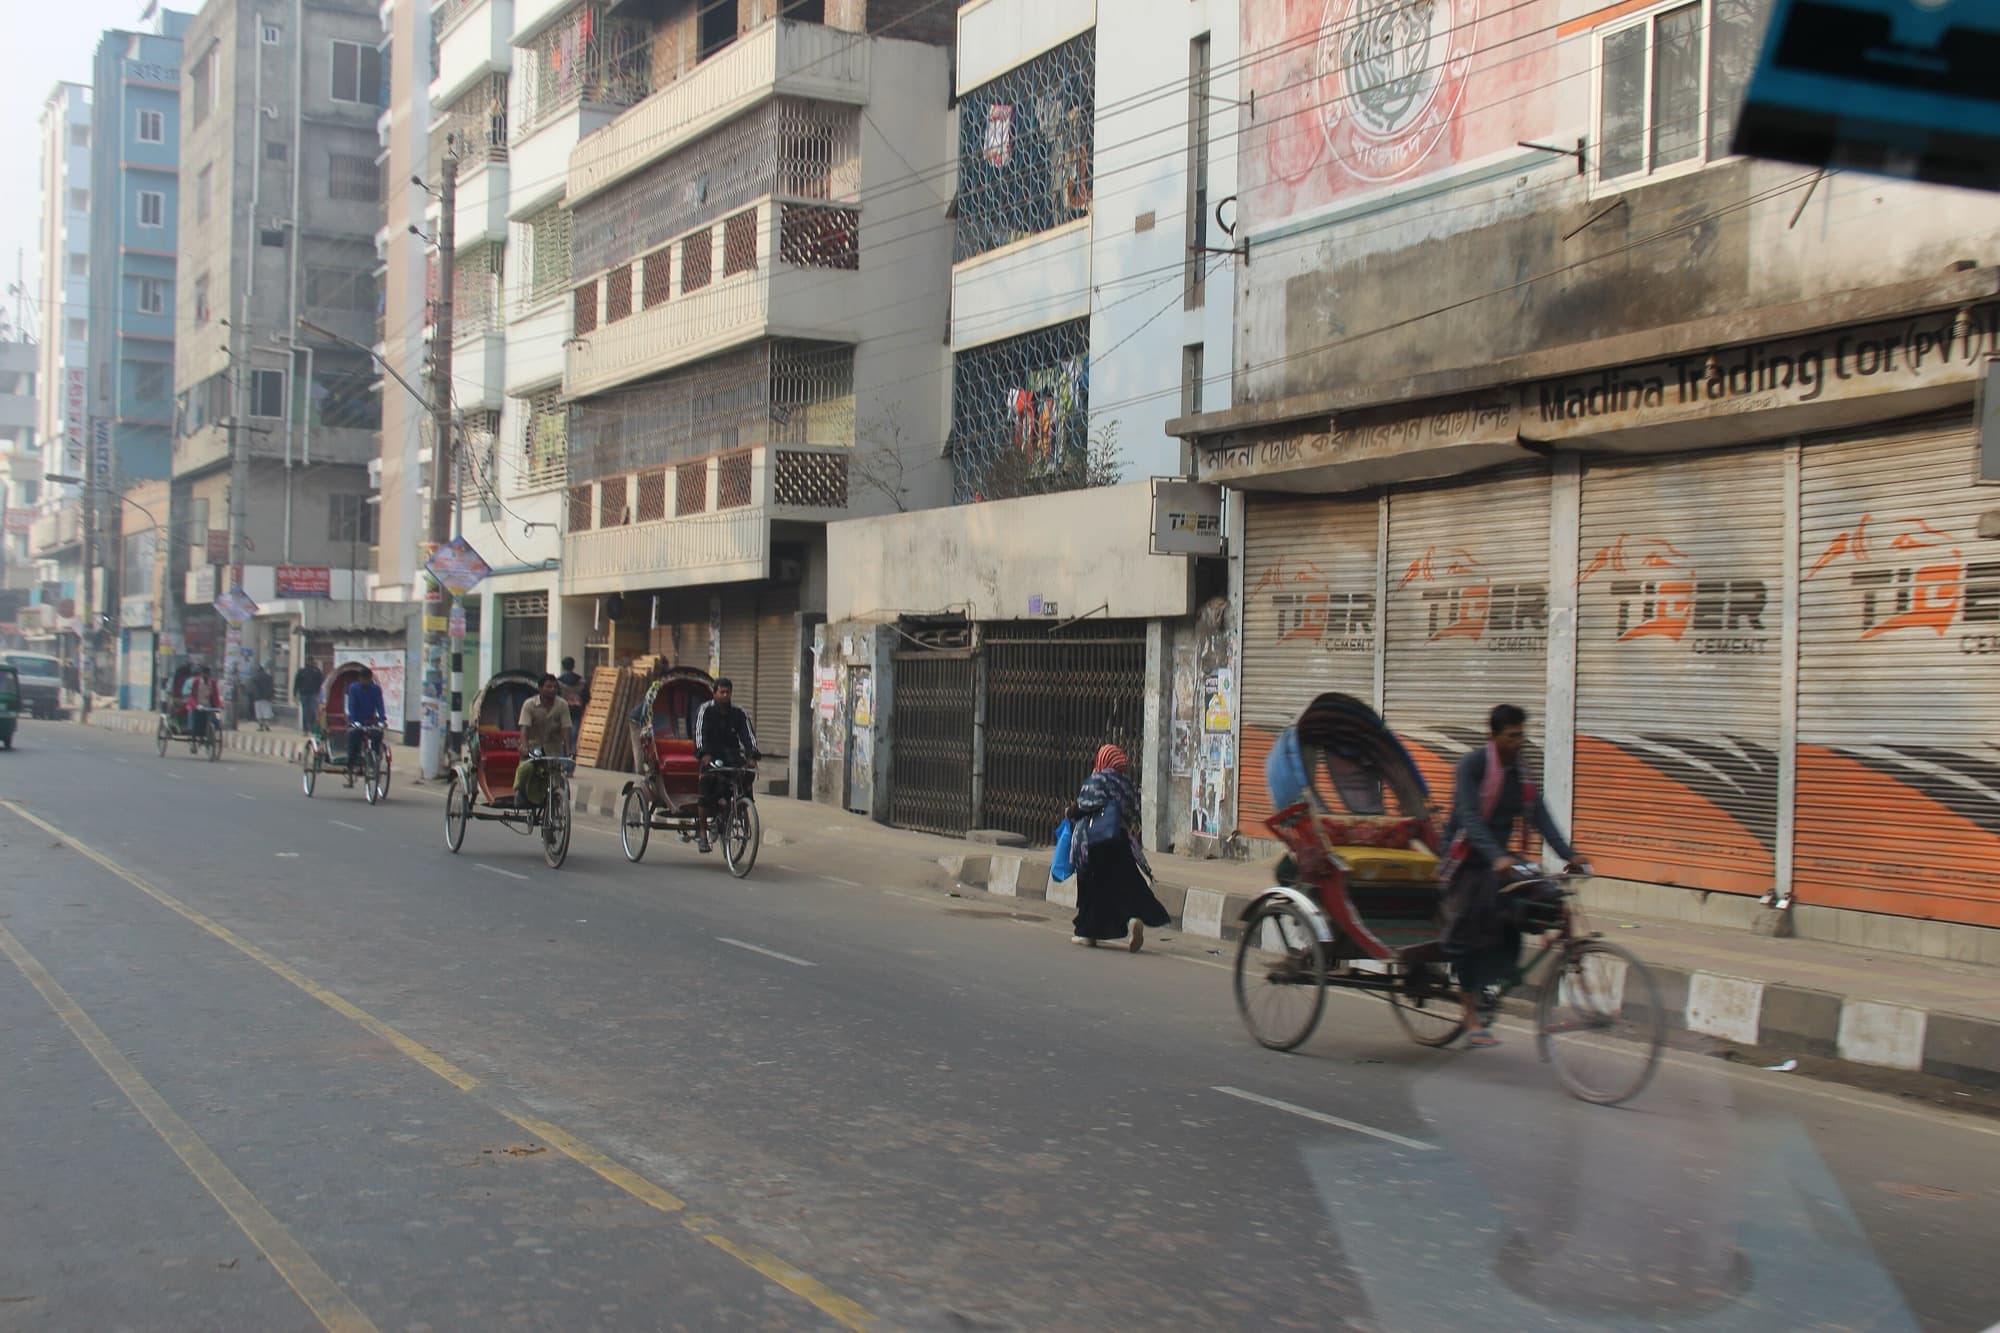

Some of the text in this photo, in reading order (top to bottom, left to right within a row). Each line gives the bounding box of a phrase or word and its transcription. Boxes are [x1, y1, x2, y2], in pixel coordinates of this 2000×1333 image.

[1539, 372, 1663, 423] Madina
[1669, 347, 1823, 401] Trading
[1207, 433, 1255, 471] মদিনা
[1169, 513, 1219, 531] TIGER
[1272, 592, 1376, 642] TIGER
[1422, 584, 1548, 641] TIGER
[1611, 580, 1768, 640] TIGER
[1326, 638, 1374, 653] CEMENT
[1692, 638, 1768, 654] CEMENT
